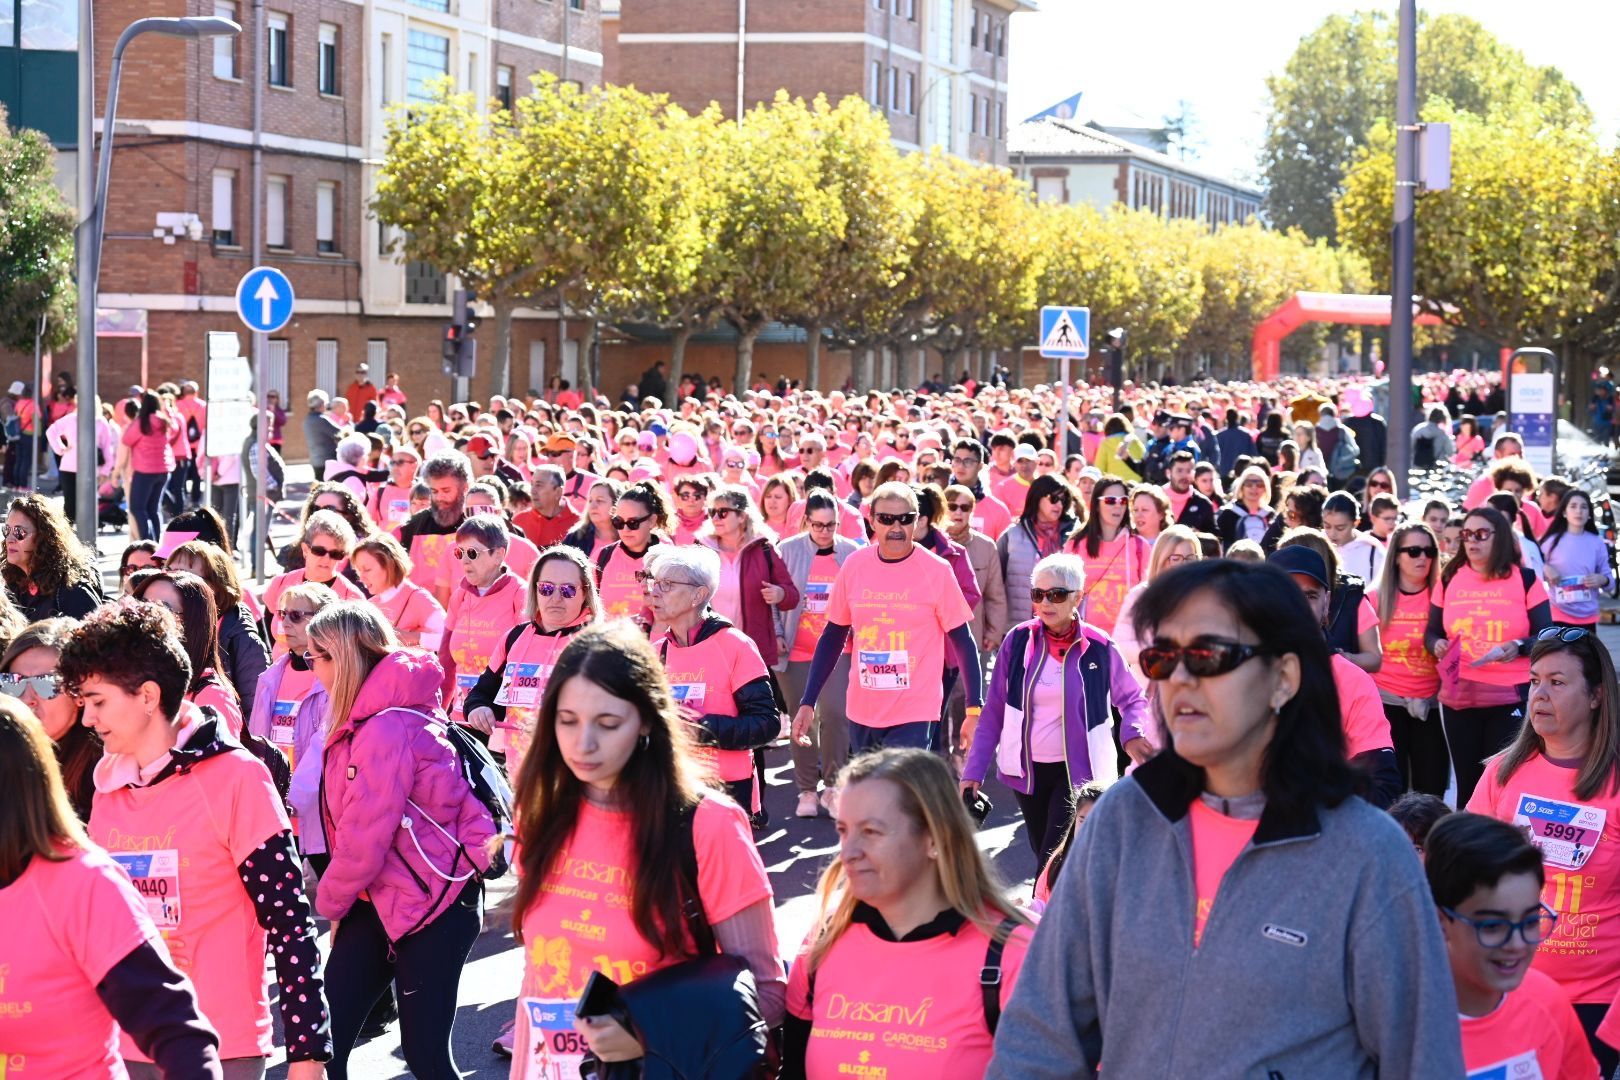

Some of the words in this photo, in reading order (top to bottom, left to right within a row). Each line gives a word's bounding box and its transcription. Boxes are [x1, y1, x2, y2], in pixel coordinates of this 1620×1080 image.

[873, 665, 897, 674] 0124
[518, 677, 540, 687] 303
[1544, 822, 1585, 842] 5997
[883, 1031, 947, 1049] CAROBELS
[838, 1063, 887, 1078] SUZUKI
